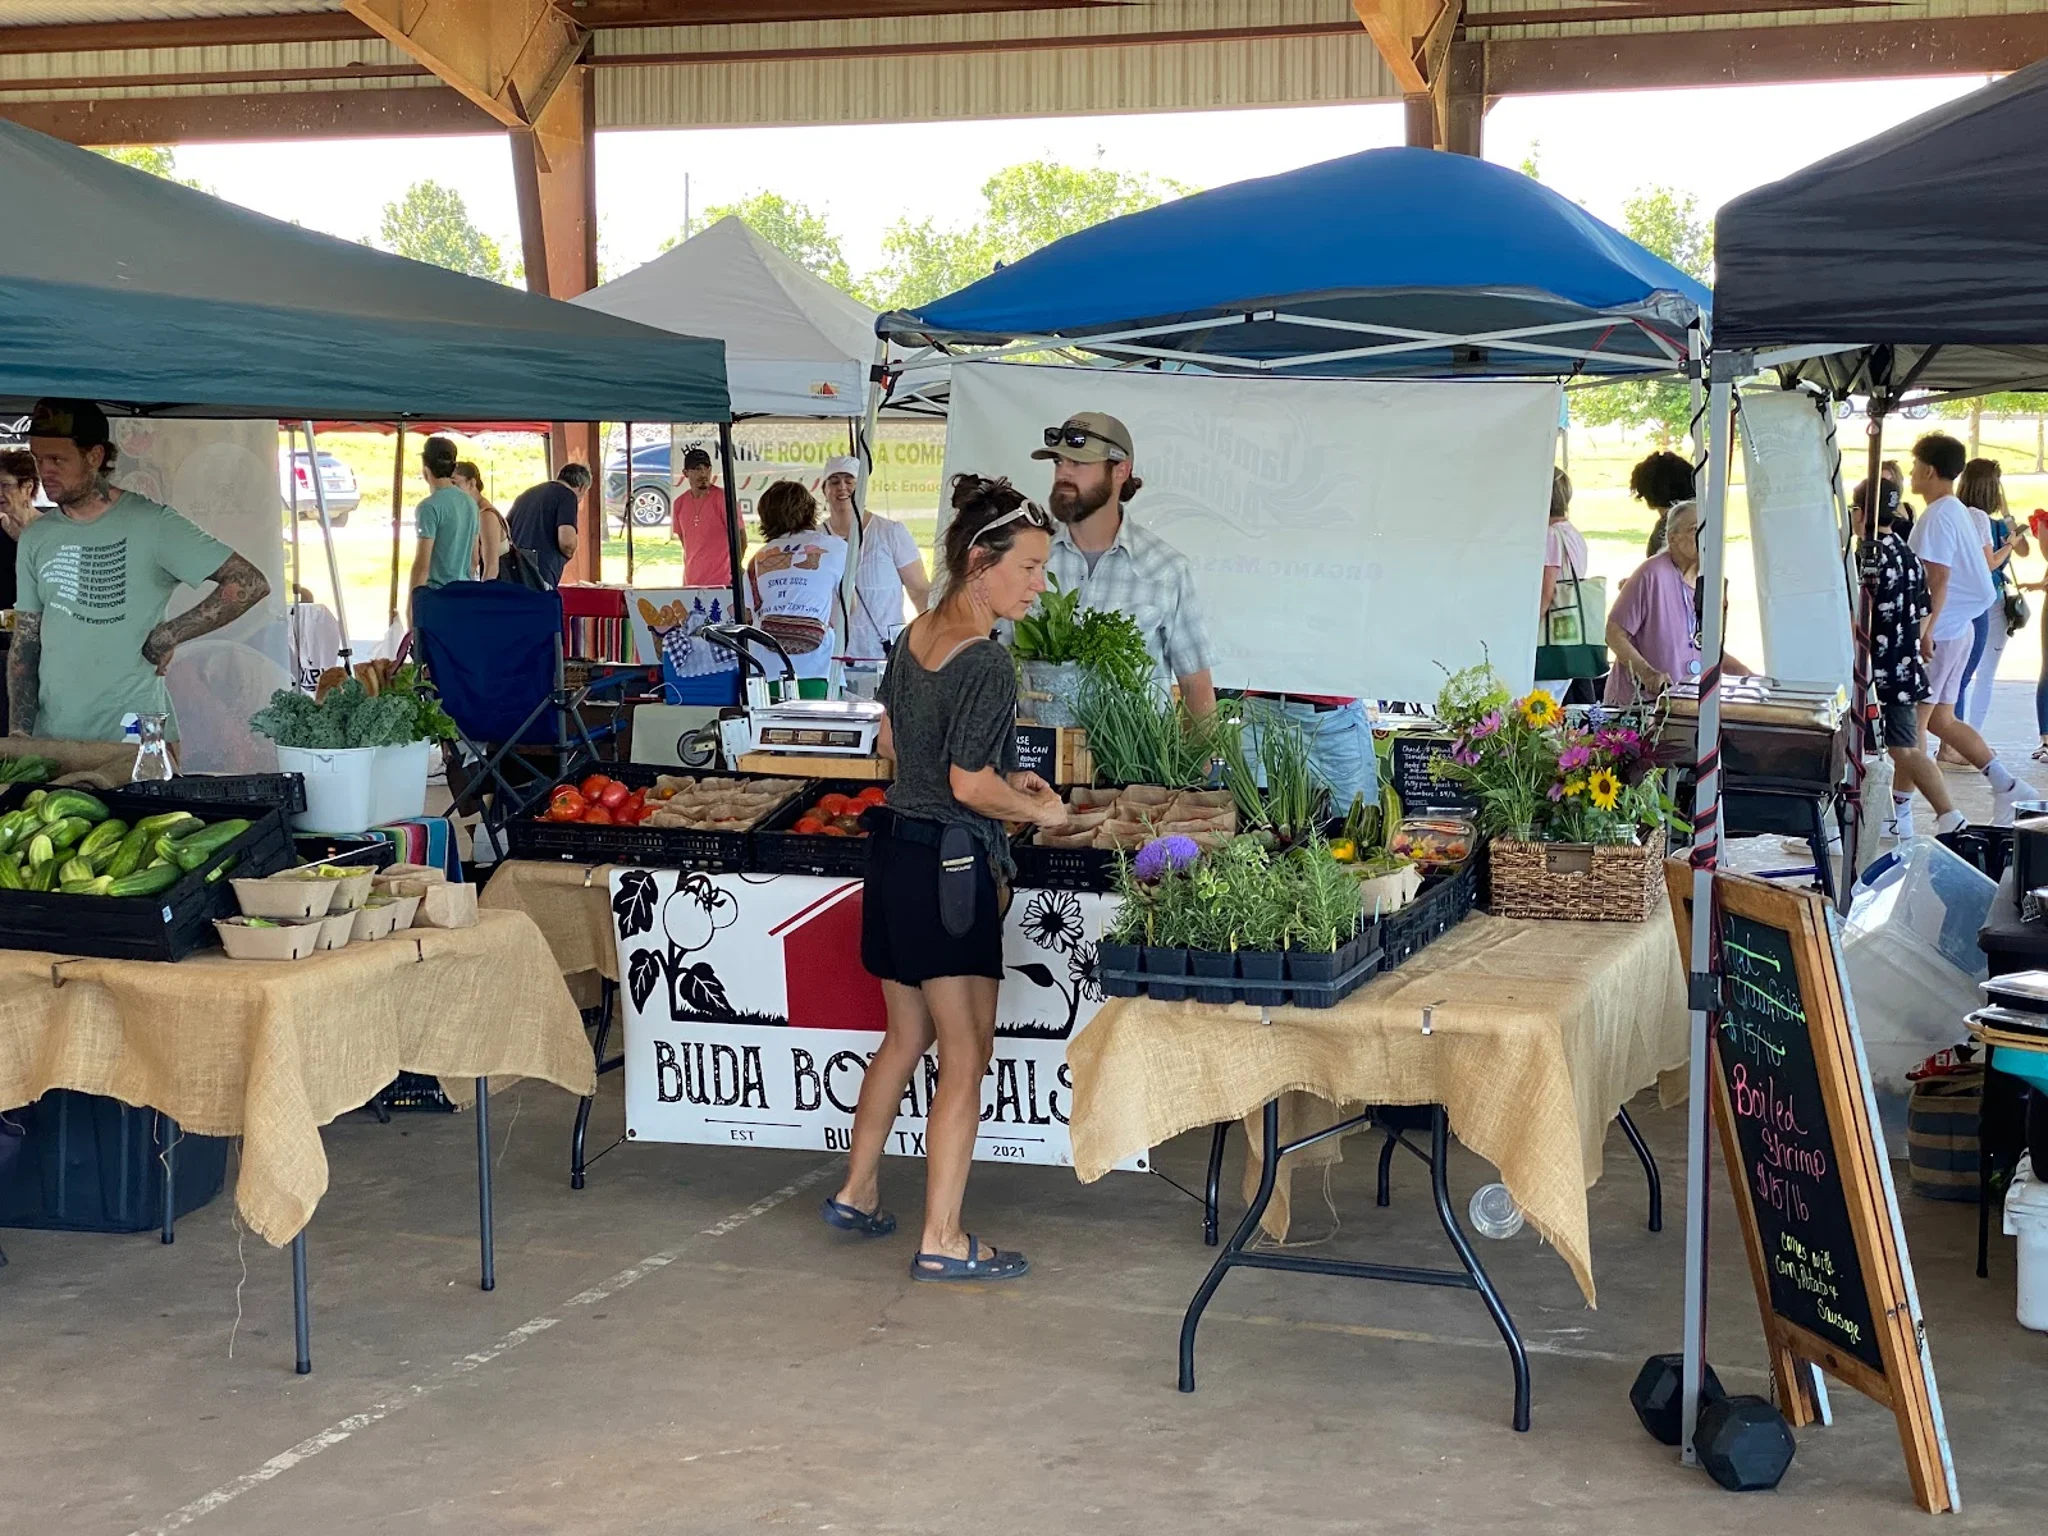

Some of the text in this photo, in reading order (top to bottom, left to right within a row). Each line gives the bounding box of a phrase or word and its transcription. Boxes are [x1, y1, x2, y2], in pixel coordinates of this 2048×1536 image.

[778, 441, 833, 463] ROOTS
[872, 480, 897, 493] Hot
[95, 537, 127, 552] EVERYONE
[93, 546, 127, 560] EVERYONE
[92, 555, 126, 569] EVERYONE
[91, 563, 126, 576] EVERYONE
[90, 572, 126, 584] EVERYONE
[90, 580, 126, 592] EVERYONE
[60, 585, 78, 595] FOOD
[89, 588, 126, 601] EVERYONE
[88, 597, 126, 609] EVERYONE
[73, 613, 85, 621] FOR
[86, 613, 126, 625] EVERYONE
[1032, 746, 1049, 754] CAN
[654, 1040, 770, 1109] BUDA
[1731, 1063, 1808, 1135] Boiled
[731, 1129, 755, 1141] EST
[895, 1131, 926, 1156] TX
[993, 1145, 1026, 1158] 2021
[1761, 1127, 1827, 1184] Shrimp
